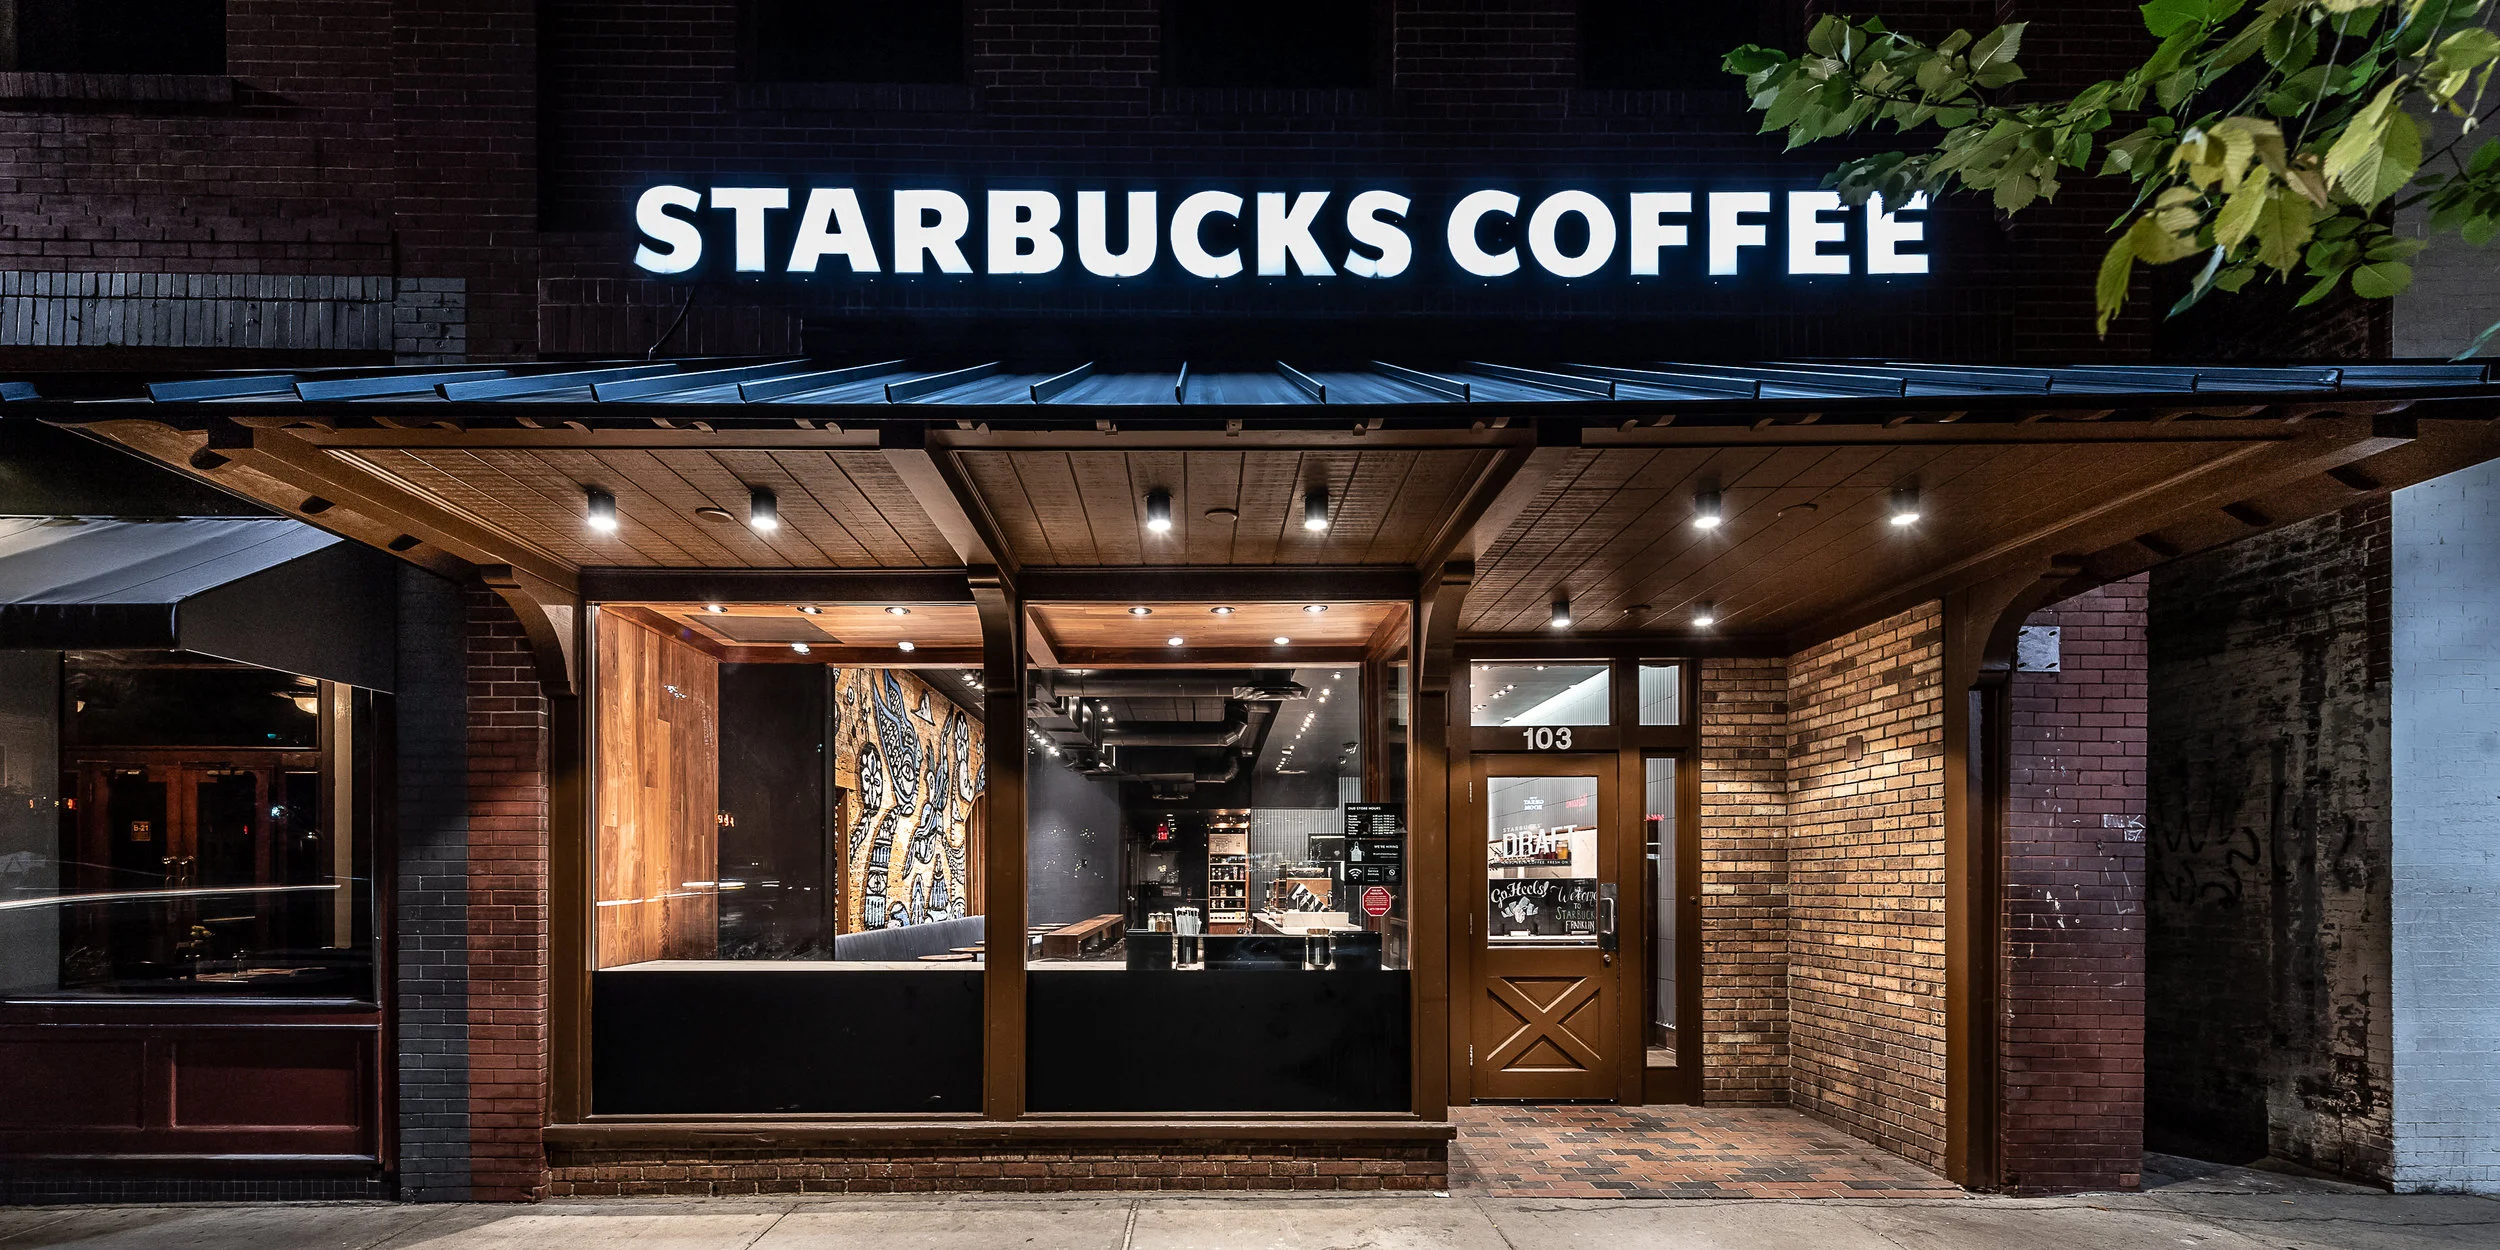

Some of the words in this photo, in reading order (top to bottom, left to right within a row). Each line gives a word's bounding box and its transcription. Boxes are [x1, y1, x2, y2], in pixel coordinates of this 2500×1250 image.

[633, 184, 1413, 280] STARBUCKS
[1447, 188, 1930, 279] COFFEE
[1522, 727, 1572, 750] 103
[1502, 823, 1541, 833] STARBUS
[1502, 824, 1578, 859] DRAFT
[1490, 888, 1508, 908] Go
[1506, 880, 1550, 898] Heels!
[1555, 906, 1596, 921] STARBUCK
